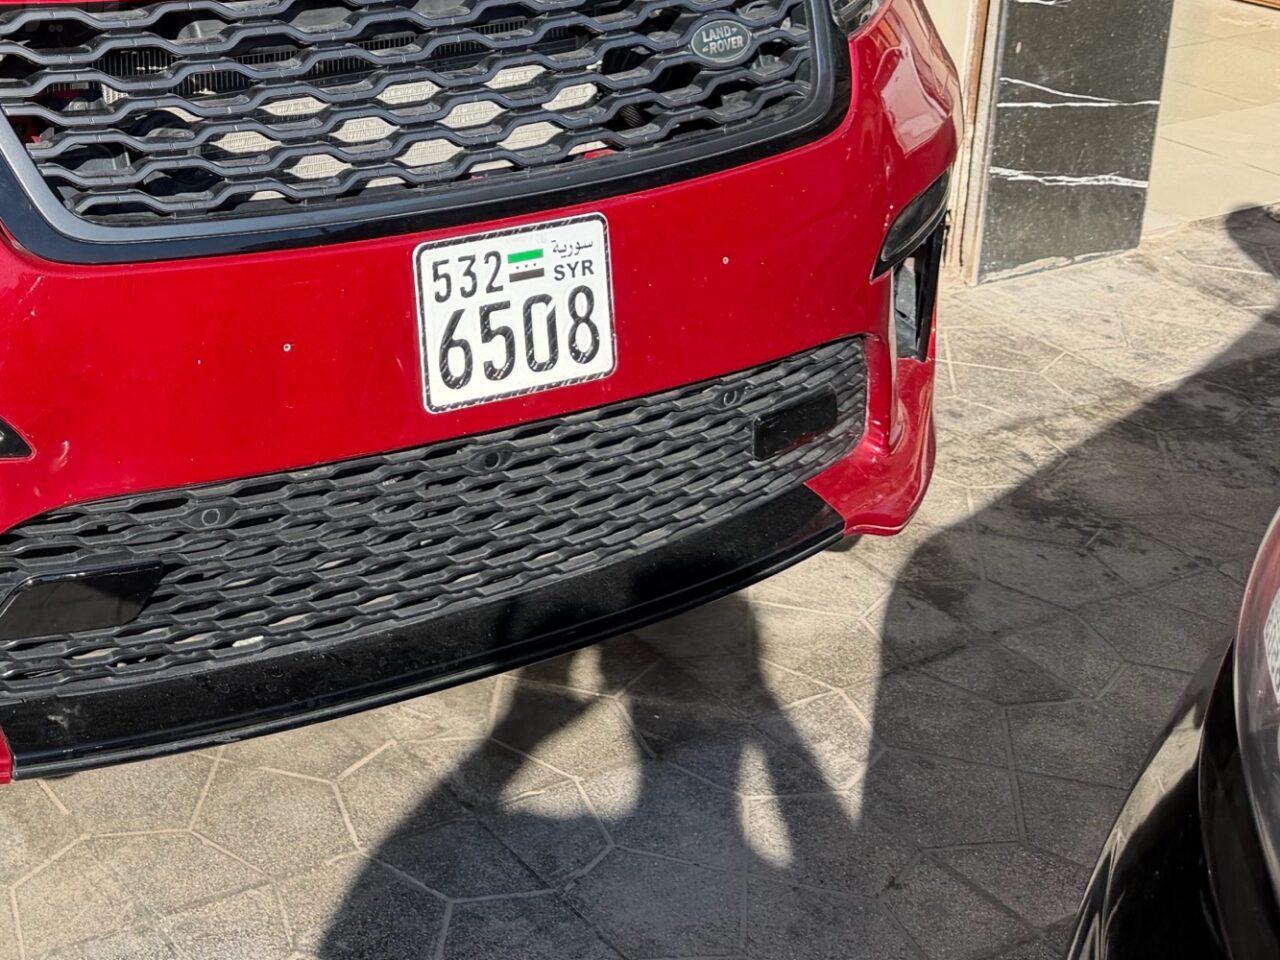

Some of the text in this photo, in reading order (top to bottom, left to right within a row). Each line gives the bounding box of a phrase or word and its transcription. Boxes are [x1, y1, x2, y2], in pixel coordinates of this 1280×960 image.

[701, 25, 733, 43] LAND
[709, 35, 745, 55] ROVER
[550, 239, 594, 259] سورية
[431, 249, 504, 304] 532
[553, 258, 595, 281] SYR
[438, 284, 601, 391] 6508
